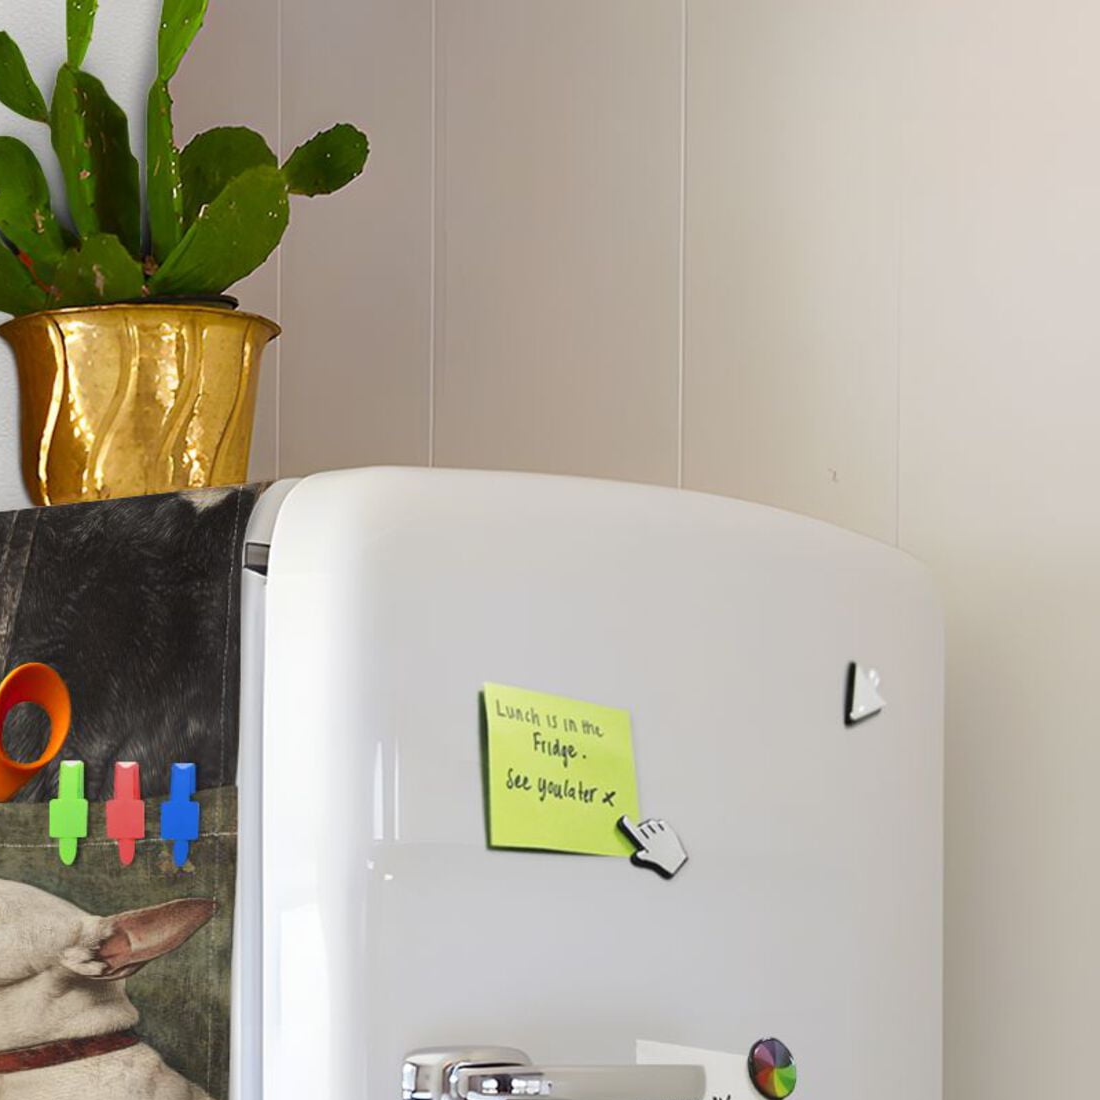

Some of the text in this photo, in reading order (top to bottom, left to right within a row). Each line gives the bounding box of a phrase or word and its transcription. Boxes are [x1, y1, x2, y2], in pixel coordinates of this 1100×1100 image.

[496, 699, 604, 738] Lunch is in the
[506, 768, 532, 790] See
